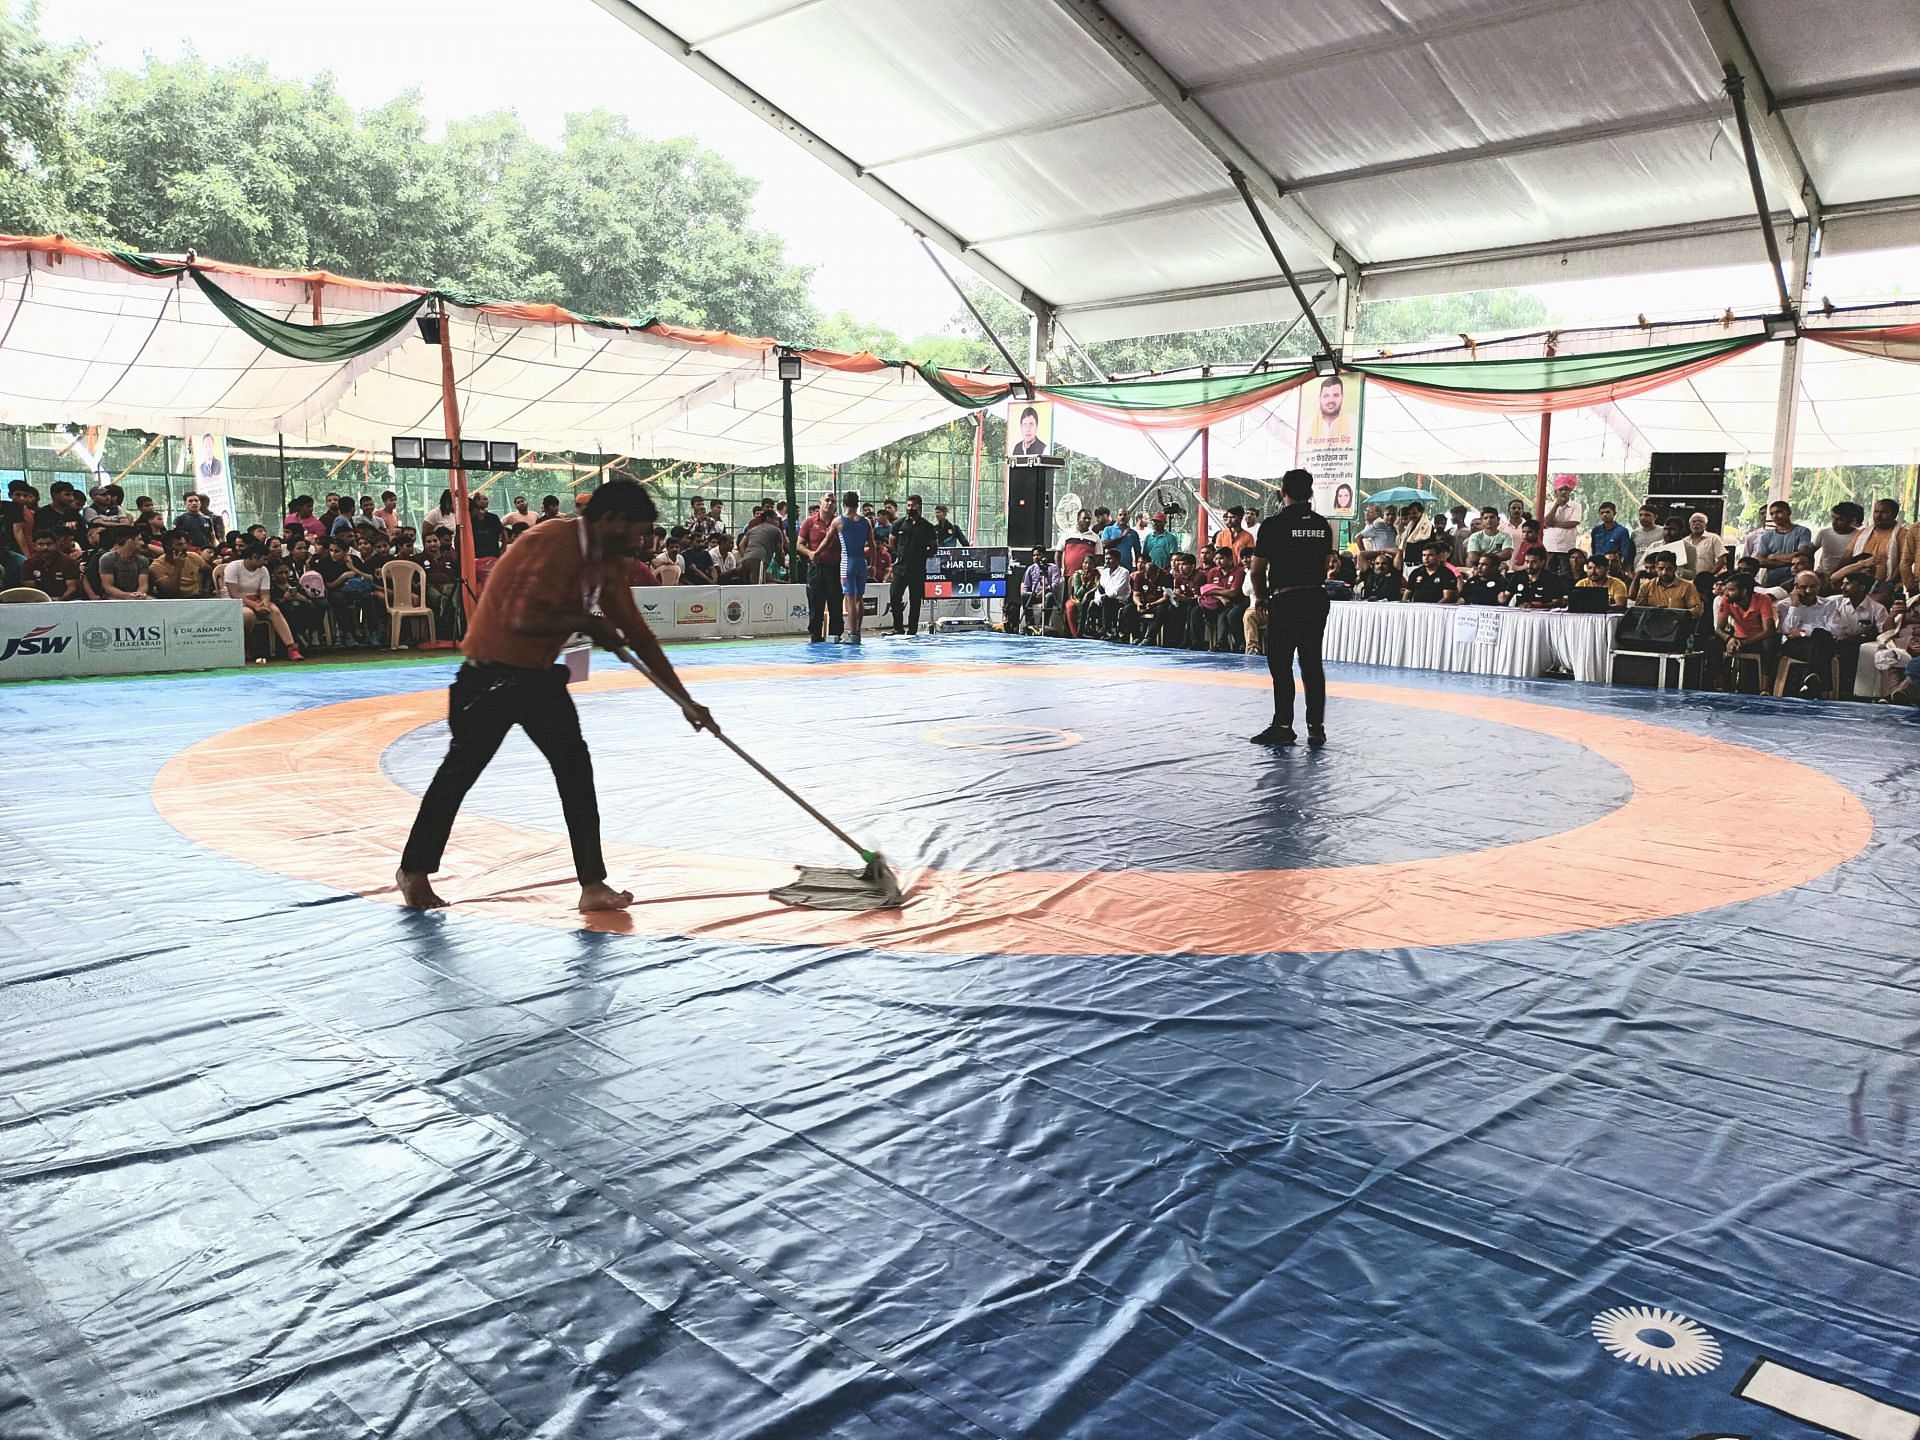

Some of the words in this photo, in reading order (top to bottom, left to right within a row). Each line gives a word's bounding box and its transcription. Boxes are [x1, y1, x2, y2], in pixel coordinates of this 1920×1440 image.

[1291, 529, 1326, 538] REFEREE
[966, 560, 984, 568] DEL
[934, 584, 942, 595] 5
[958, 583, 974, 594] 20
[988, 583, 997, 595] 4
[114, 626, 161, 642] IMS
[0, 636, 72, 661] JSW
[113, 640, 162, 648] GHAZIABAD
